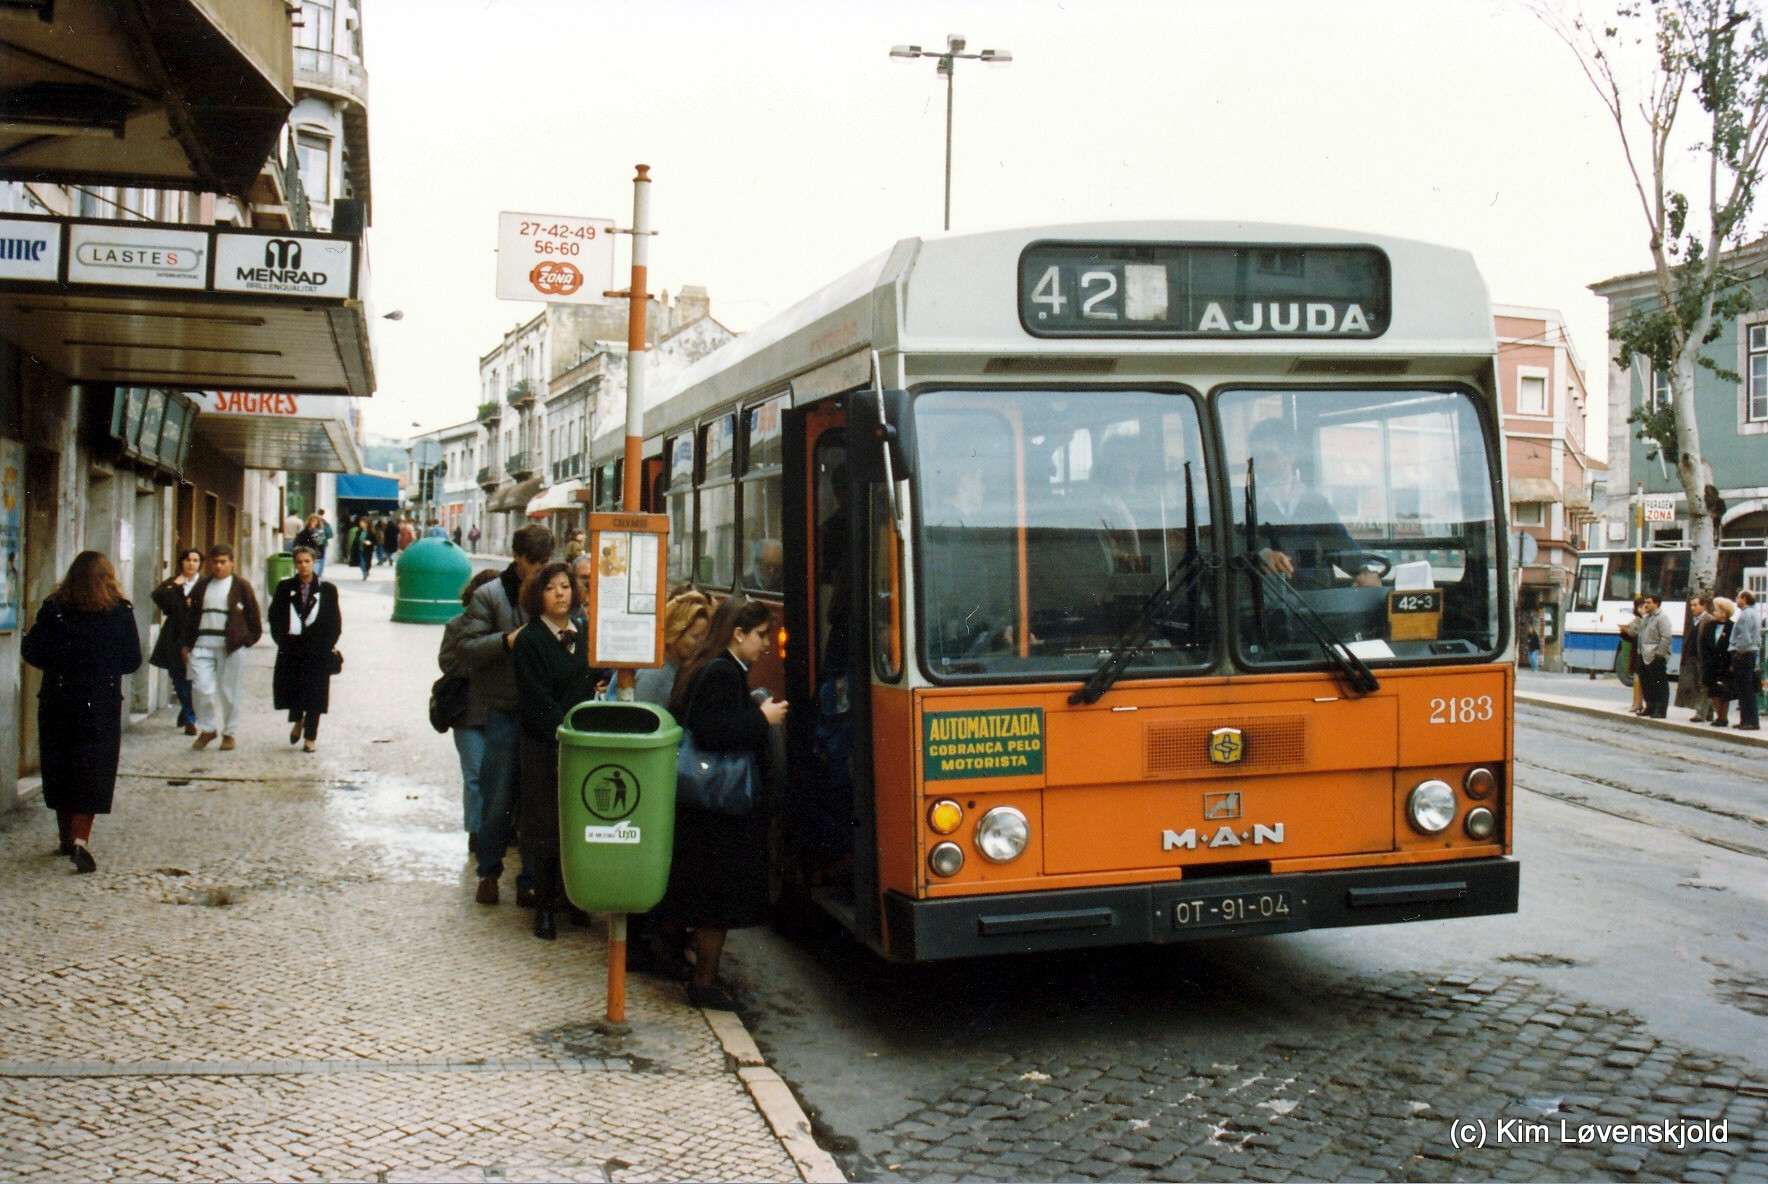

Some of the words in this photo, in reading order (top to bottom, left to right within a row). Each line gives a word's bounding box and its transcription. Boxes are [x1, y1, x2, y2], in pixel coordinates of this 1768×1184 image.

[520, 222, 596, 240] 27-42-49
[93, 248, 178, 266] LASTES
[534, 240, 580, 256] 56-60
[236, 267, 328, 286] MENRAD
[538, 272, 574, 284] ZONA
[1199, 302, 1371, 332] AJUDA
[214, 391, 298, 415] SAGRES
[1647, 510, 1672, 521] ZONA
[1398, 595, 1433, 610] 42-3
[1429, 695, 1493, 724] 2183
[929, 713, 1040, 741] AUTOMATIZADA
[929, 742, 1003, 756] COBRANÇA
[1008, 739, 1041, 751] PELO
[941, 755, 1027, 771] MOTORISTA
